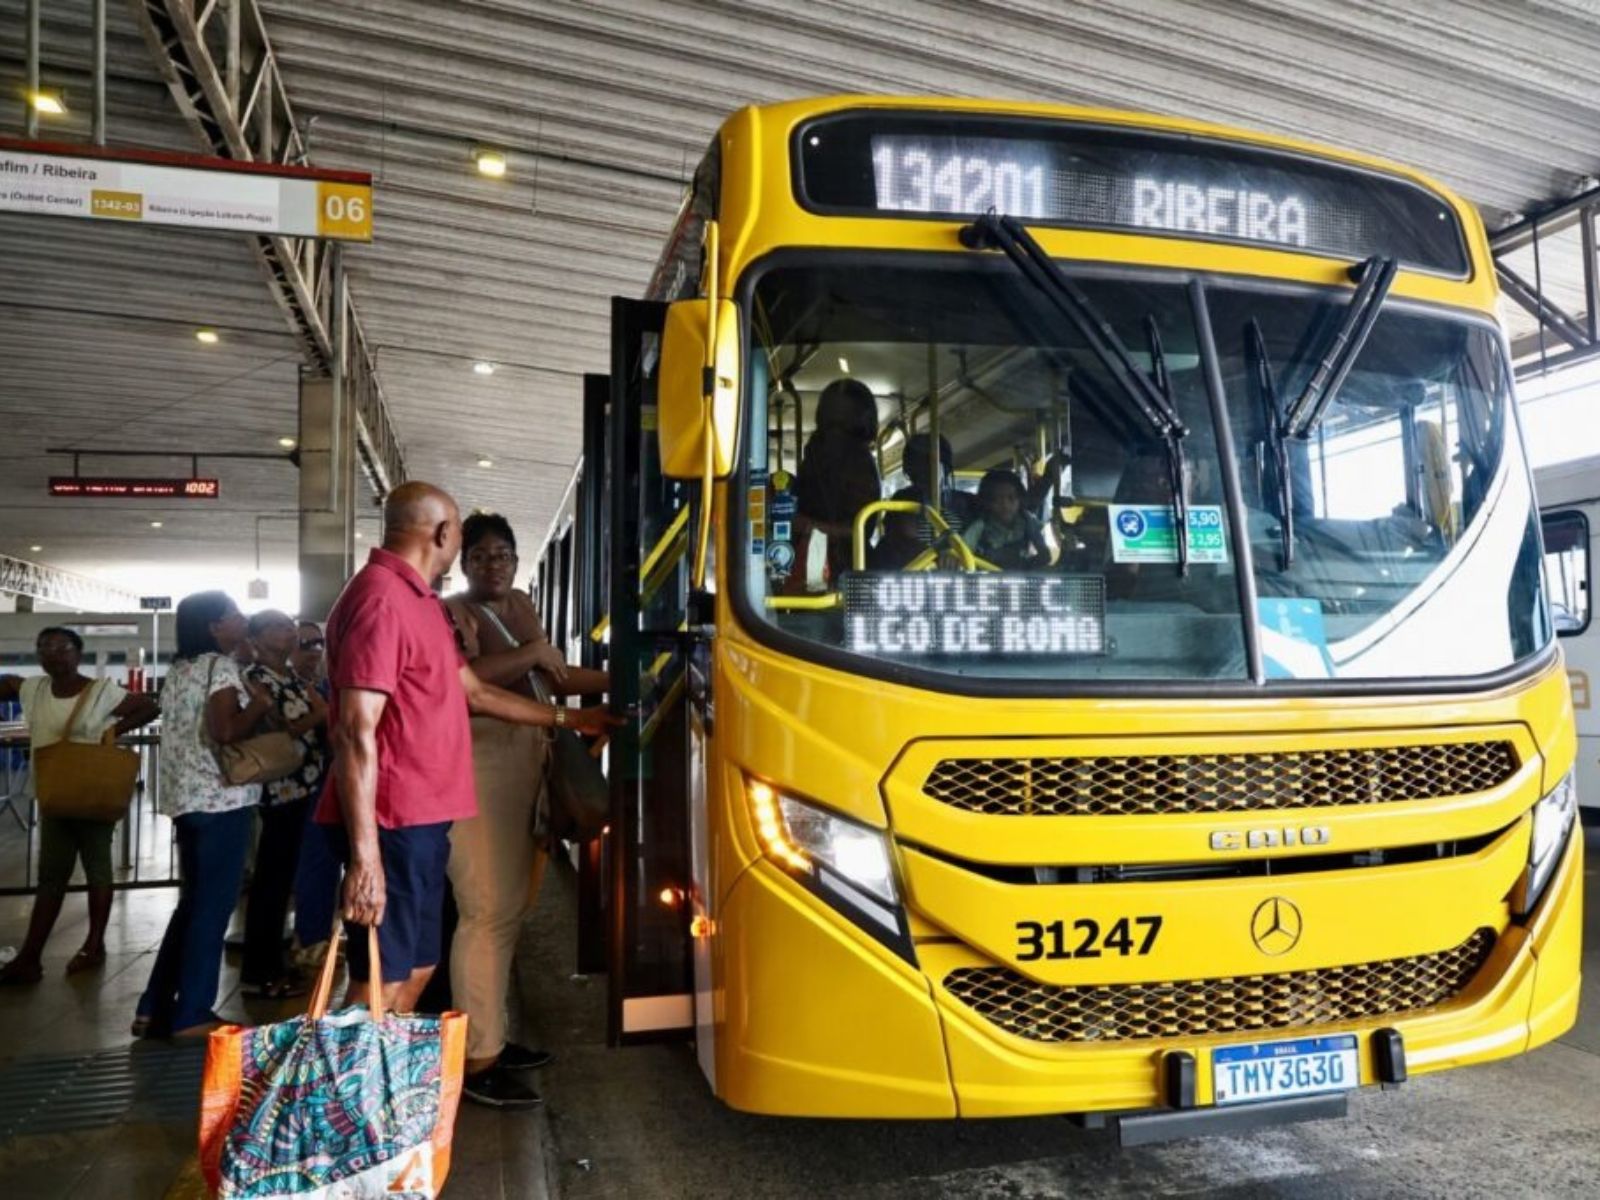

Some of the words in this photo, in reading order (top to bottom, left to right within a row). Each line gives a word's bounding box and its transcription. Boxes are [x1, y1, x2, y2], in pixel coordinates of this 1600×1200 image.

[32, 162, 39, 175] /
[42, 163, 98, 181] Ribeira
[325, 195, 366, 222] 06
[876, 577, 1026, 612] OUTLET
[853, 615, 930, 651] LGO
[943, 616, 990, 651] DE
[1003, 616, 1099, 651] ROMA
[1209, 826, 1331, 851] CAIO
[1015, 915, 1164, 962] 31247
[1226, 1053, 1344, 1096] TMY3G30
